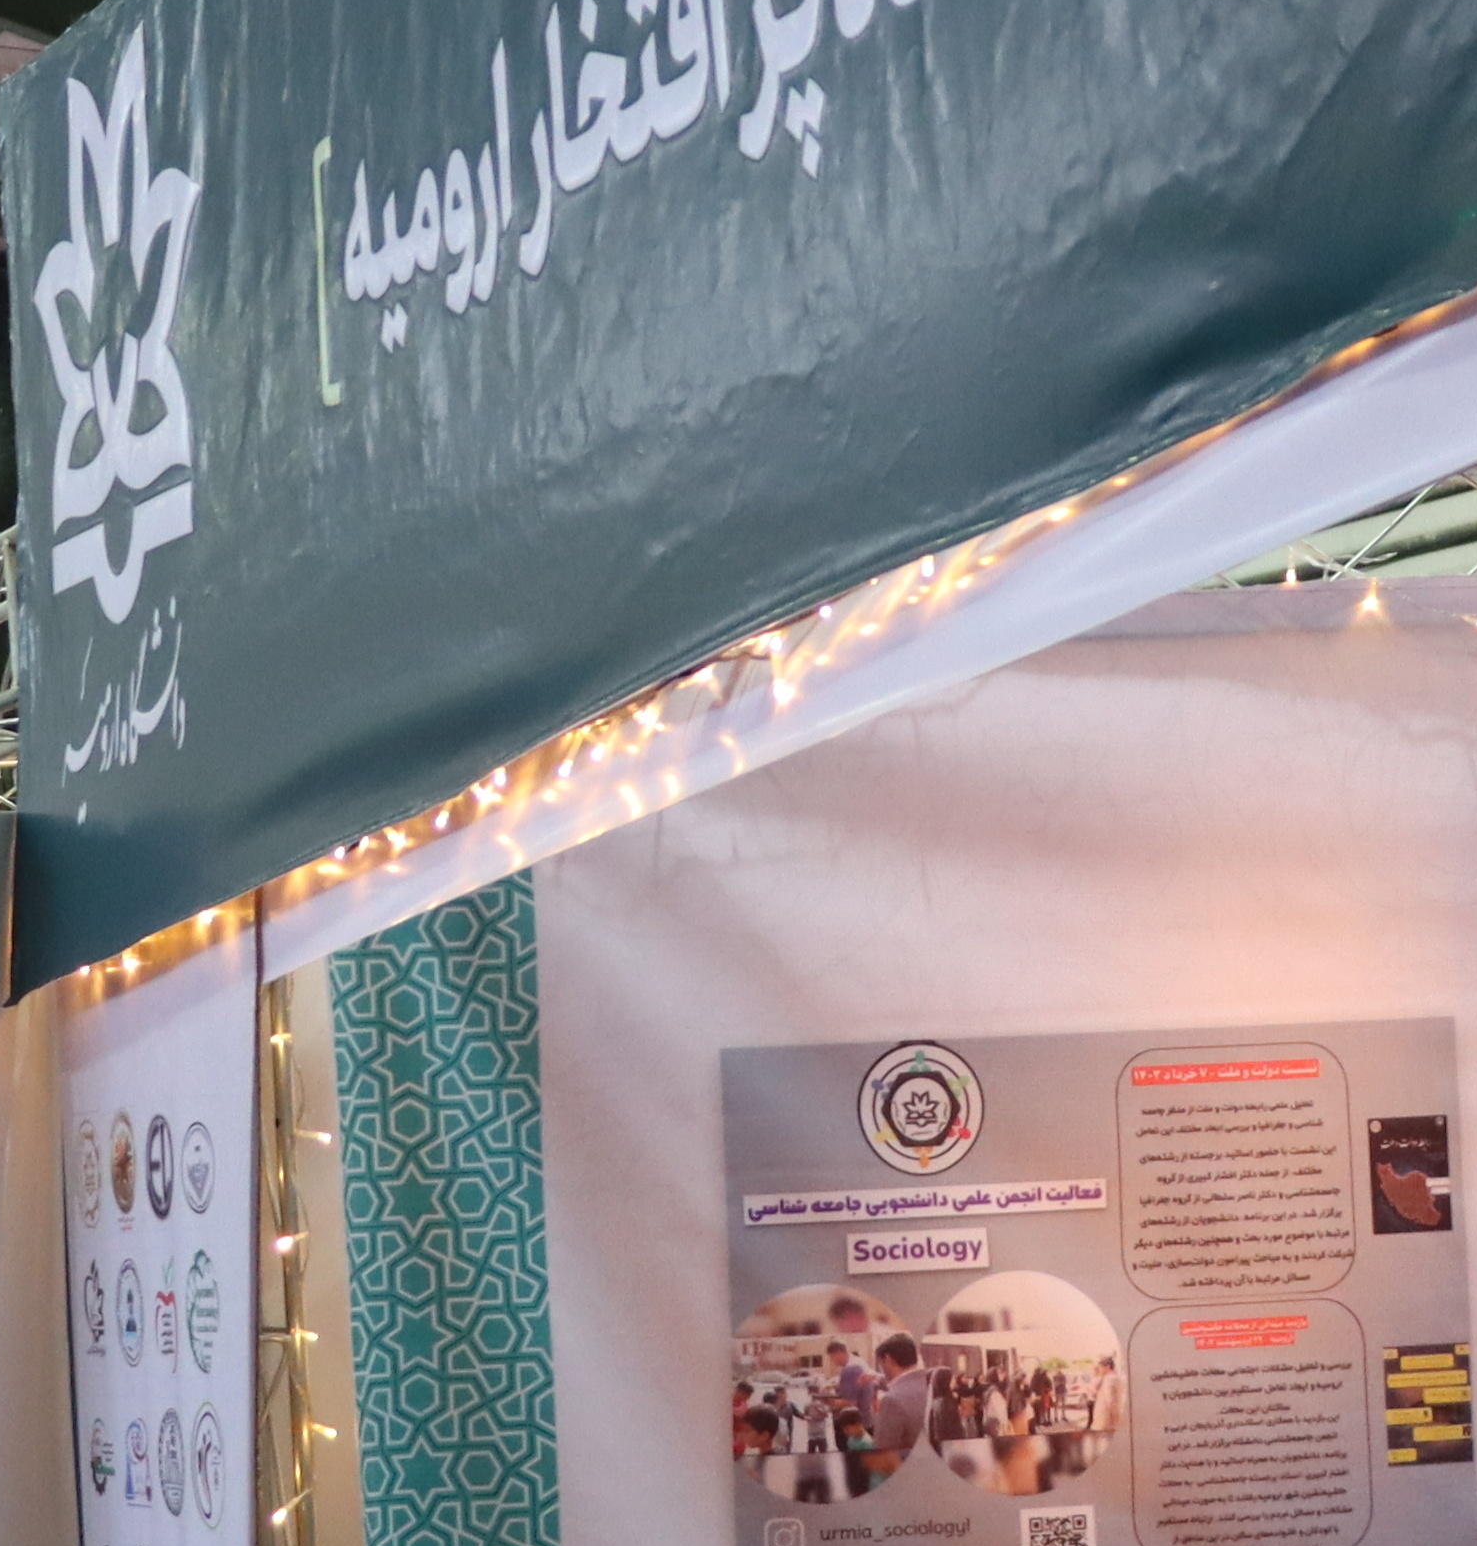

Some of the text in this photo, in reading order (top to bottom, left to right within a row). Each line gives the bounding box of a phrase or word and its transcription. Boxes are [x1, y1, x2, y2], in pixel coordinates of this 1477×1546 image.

[342, 40, 516, 352] ارومیه
[747, 1182, 1103, 1222] فعالیت انجمن علمی دانشجویی جامعه شناسی
[854, 1237, 983, 1262] Sociology
